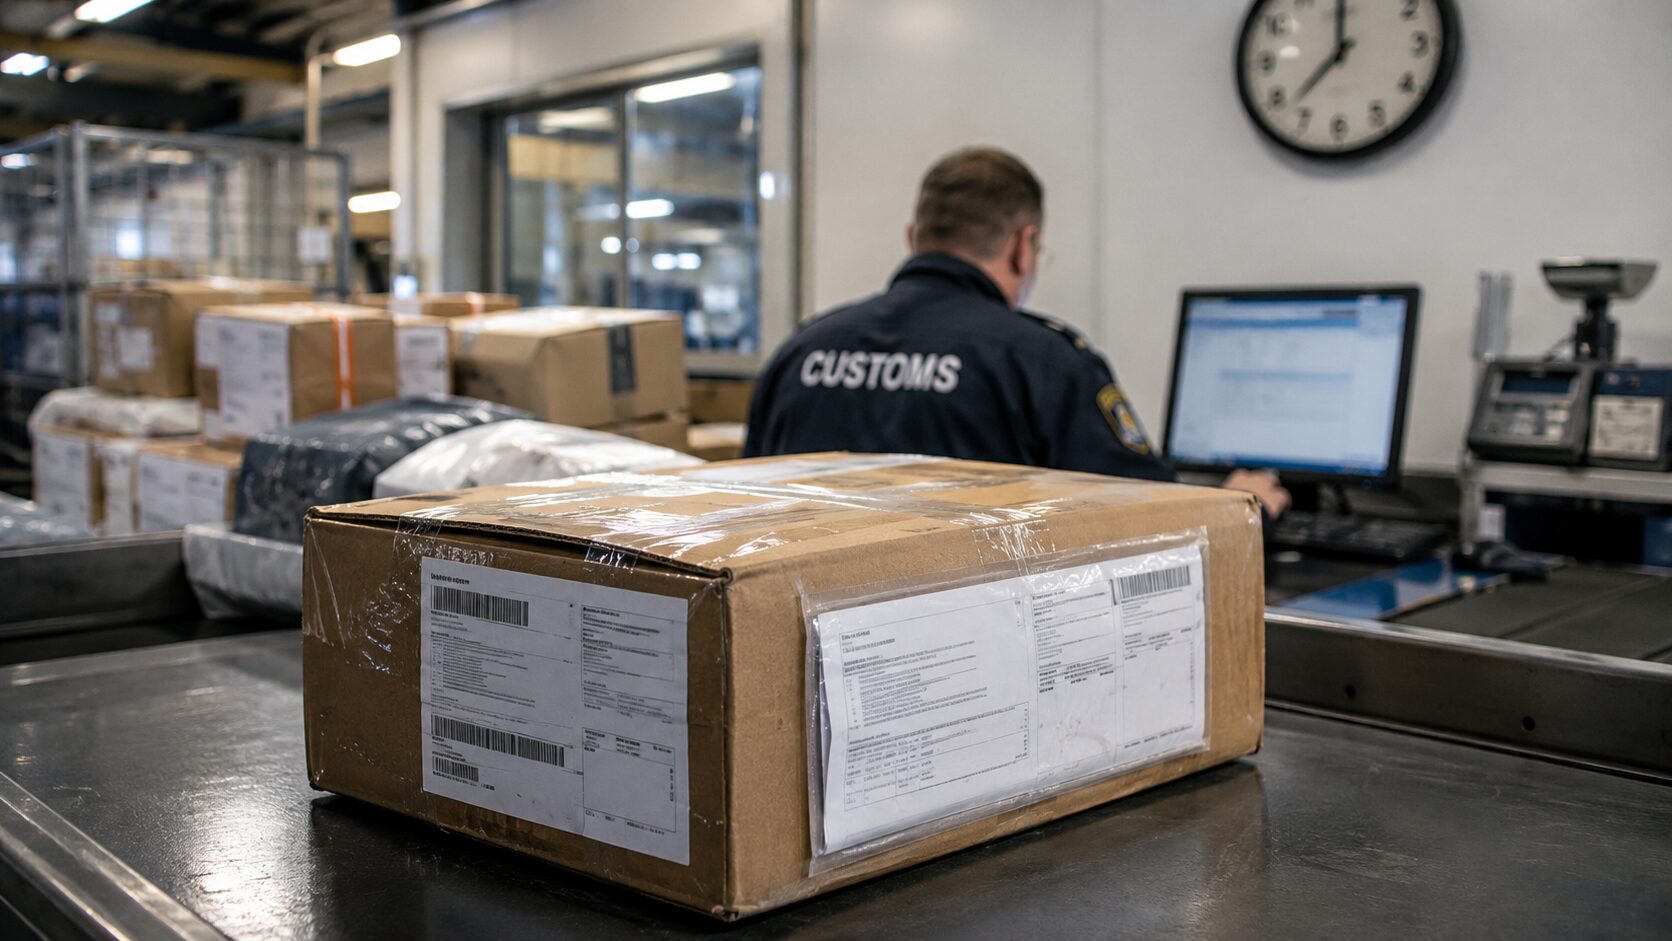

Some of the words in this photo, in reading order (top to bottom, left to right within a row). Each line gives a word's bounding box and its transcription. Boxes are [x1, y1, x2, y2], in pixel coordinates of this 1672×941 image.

[1411, 31, 1429, 57] 3
[1398, 71, 1415, 94] 4
[1297, 106, 1313, 136] 7
[1330, 113, 1348, 140] 6
[1368, 100, 1386, 127] 5
[801, 350, 961, 393] CUSTOMS
